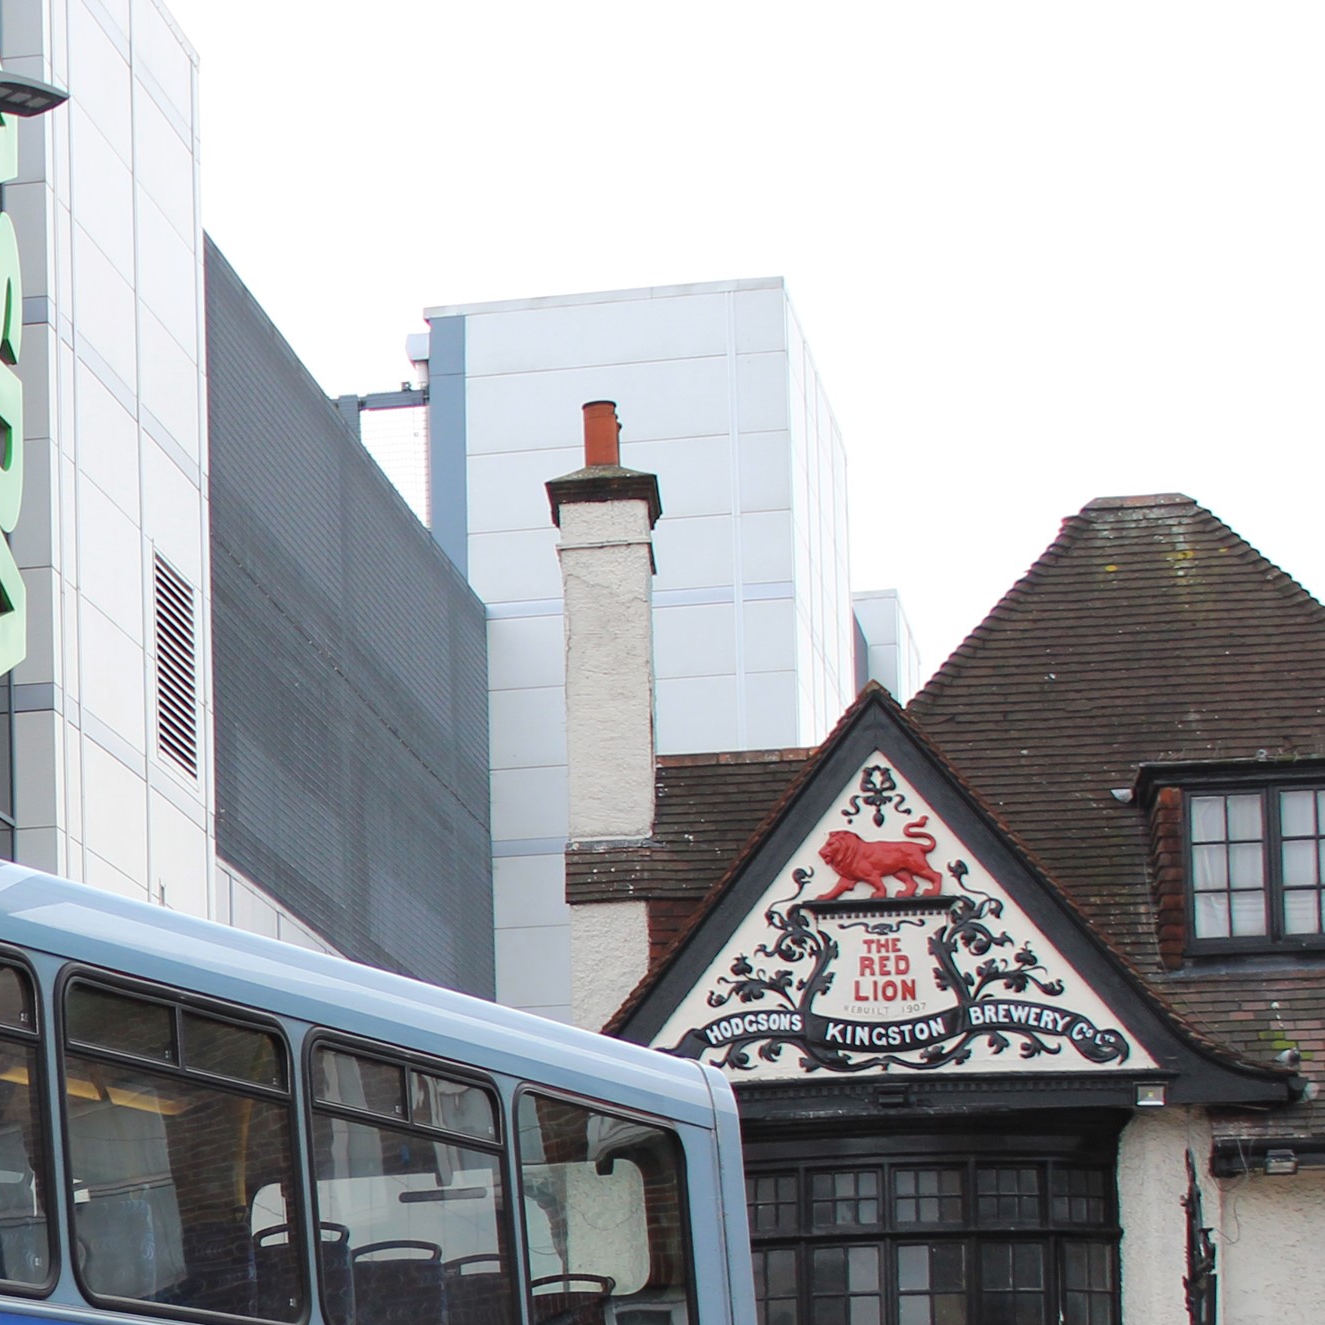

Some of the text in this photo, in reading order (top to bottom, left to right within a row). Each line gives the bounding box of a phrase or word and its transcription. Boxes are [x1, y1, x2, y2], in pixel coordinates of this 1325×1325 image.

[863, 938, 901, 954] THE
[859, 955, 910, 976] RED
[854, 979, 916, 1001] LION
[844, 1003, 927, 1015] REBUILT 1907
[705, 1013, 803, 1045] HODGSONS
[825, 1017, 946, 1046] KINGSTON
[969, 1004, 1070, 1032] BREWERY
